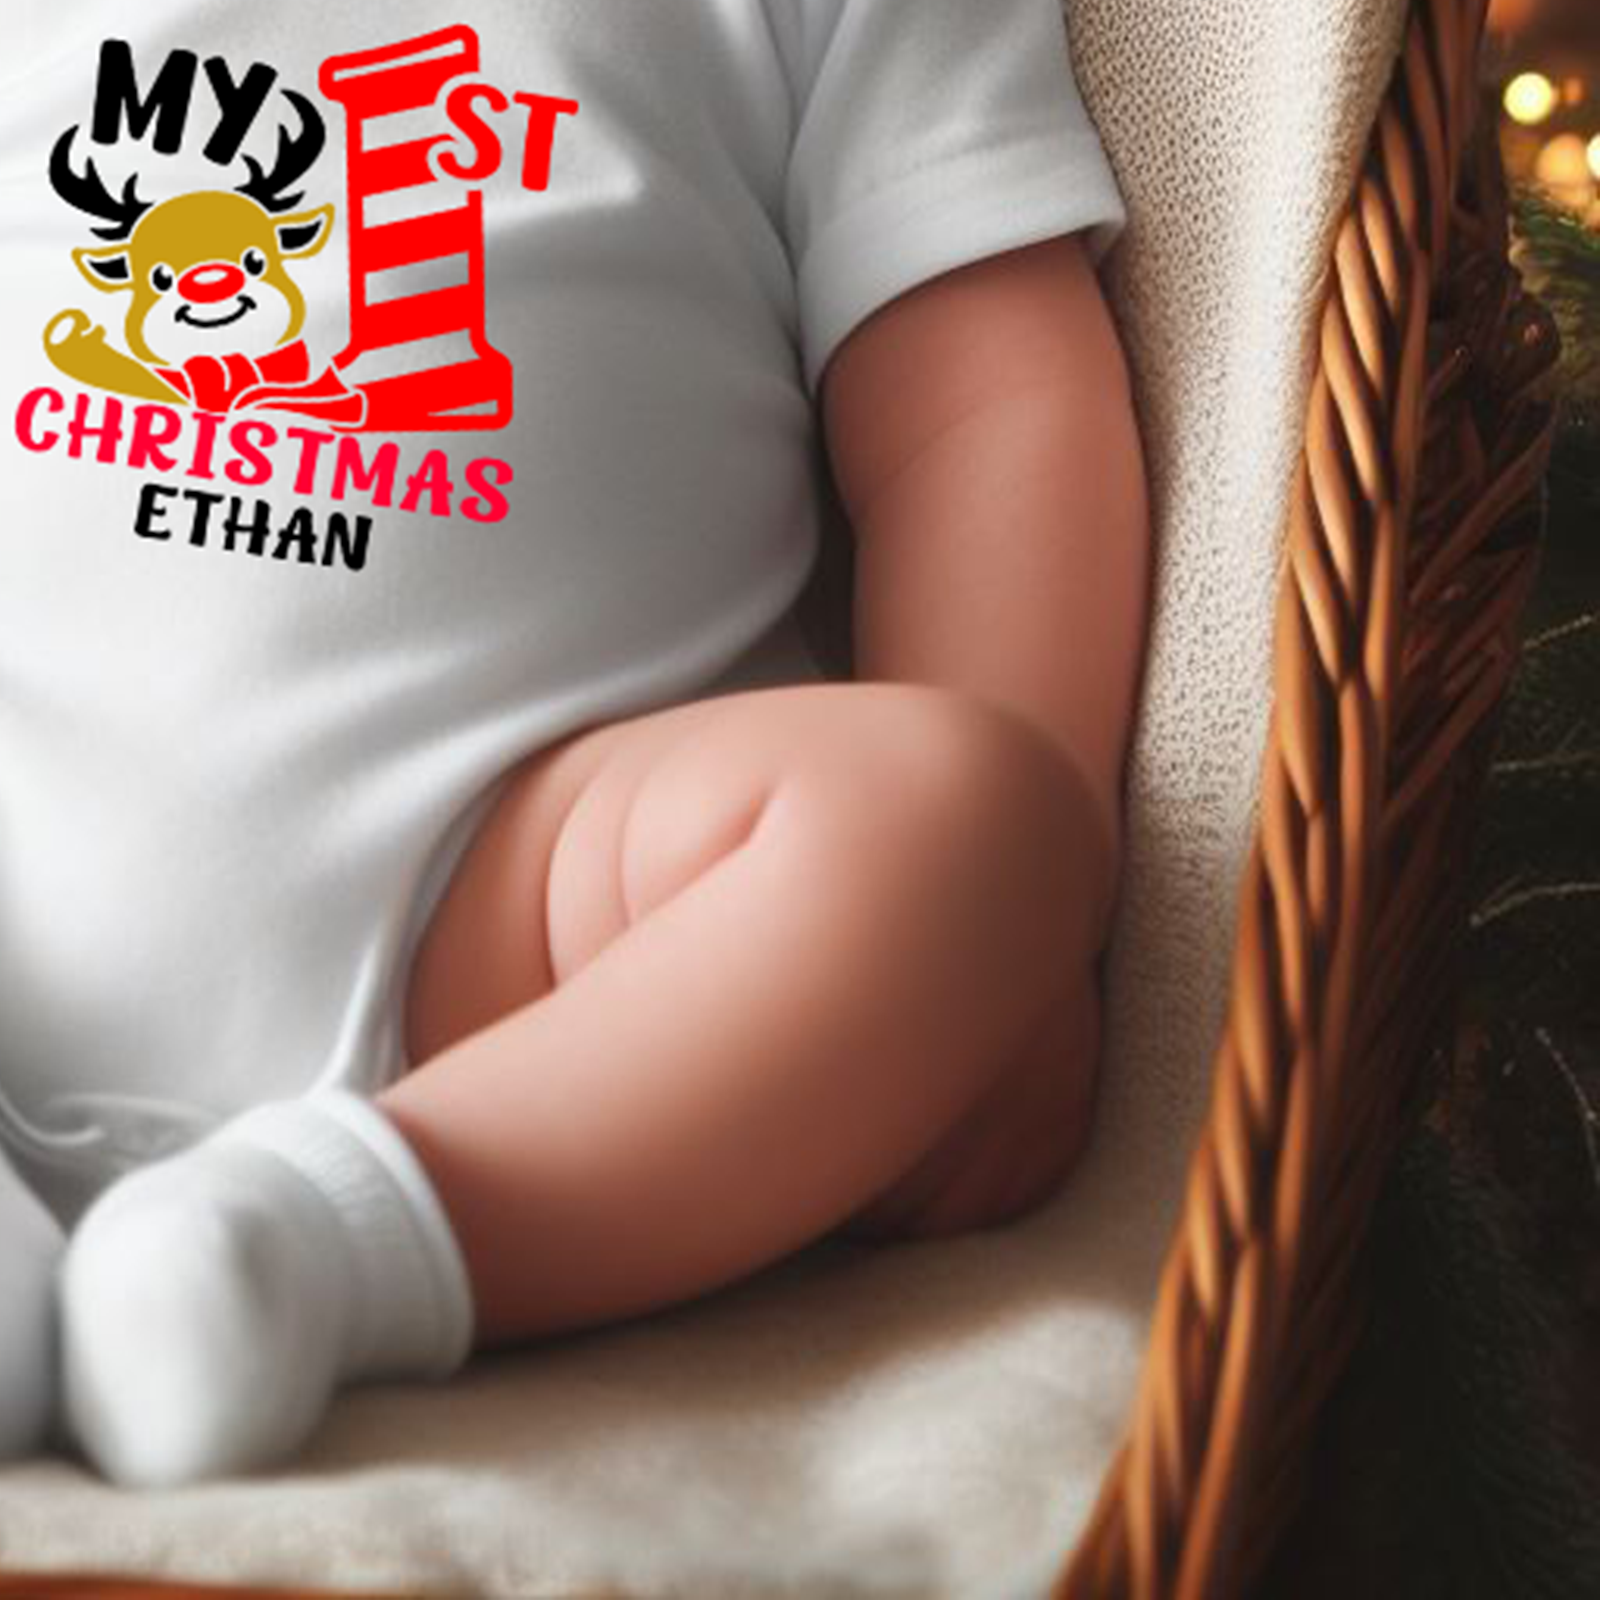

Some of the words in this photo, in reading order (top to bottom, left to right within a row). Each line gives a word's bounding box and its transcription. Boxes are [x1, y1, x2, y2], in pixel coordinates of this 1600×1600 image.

[91, 39, 278, 166] MY
[15, 387, 514, 523] CHRISTMAS
[134, 483, 372, 571] ETHAN
